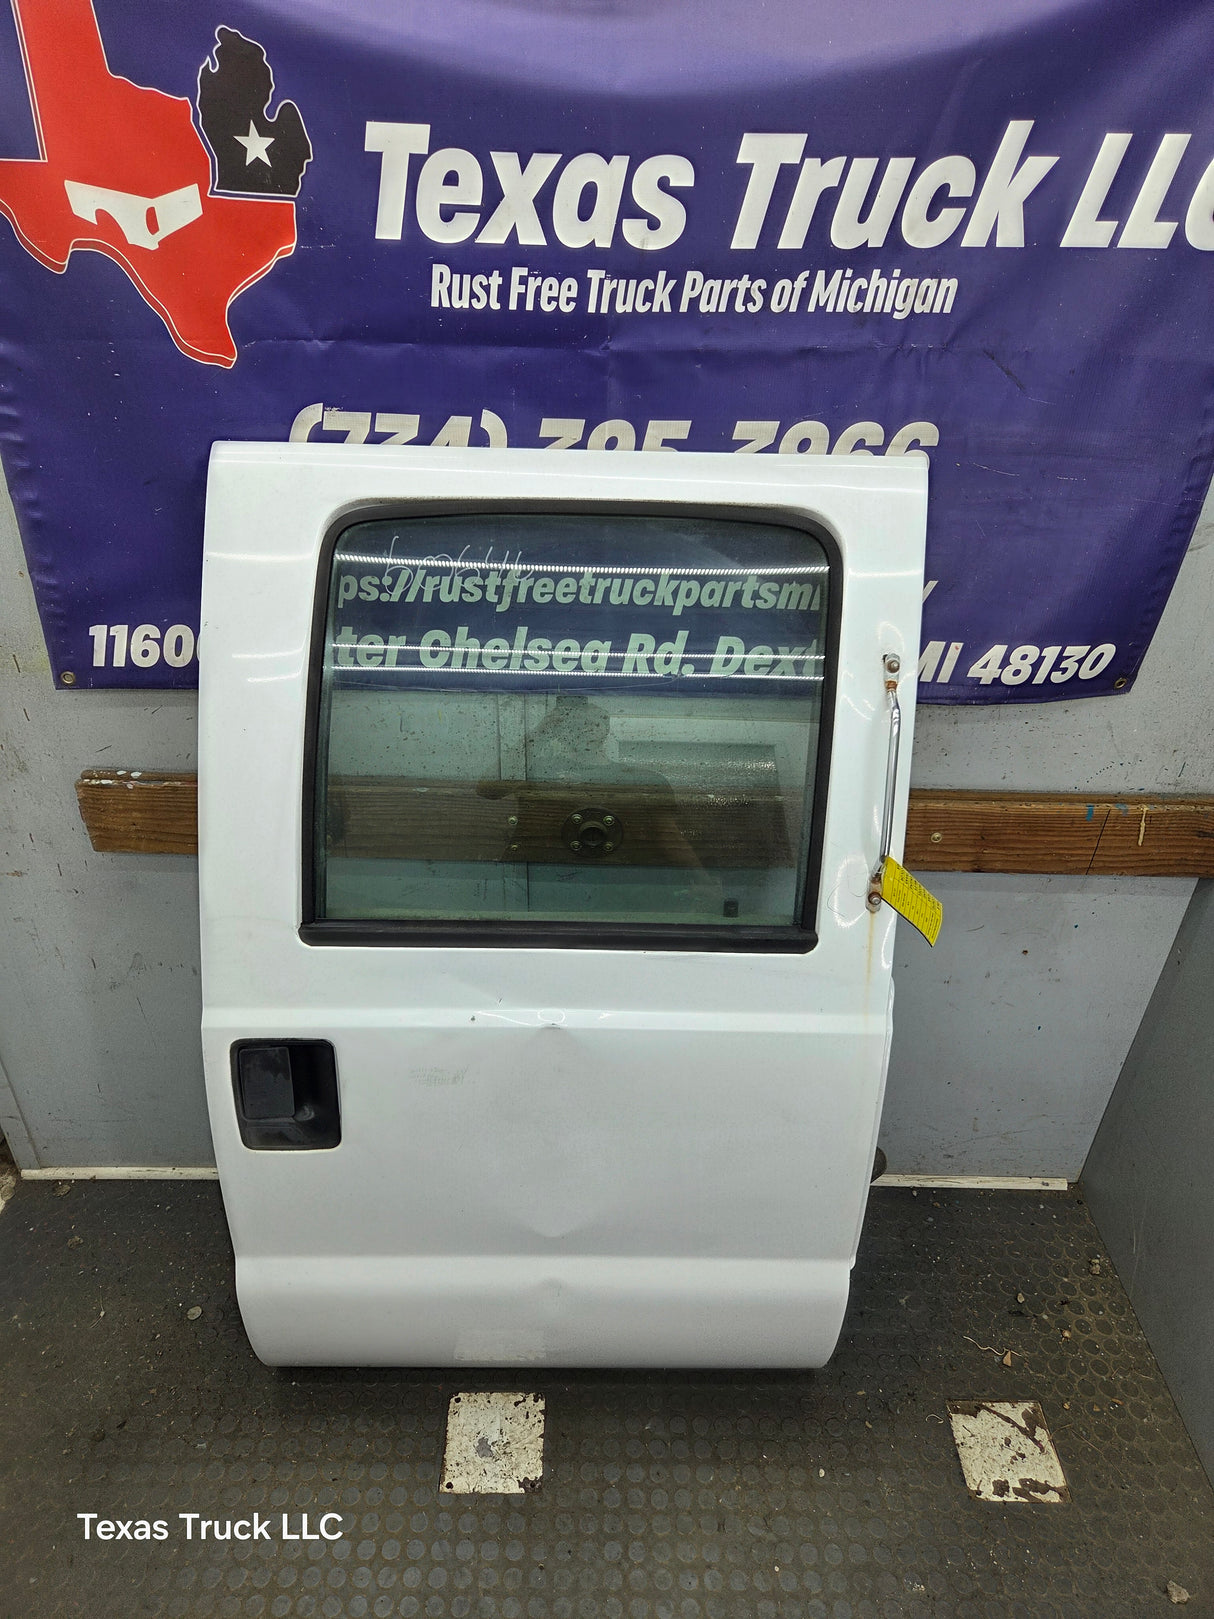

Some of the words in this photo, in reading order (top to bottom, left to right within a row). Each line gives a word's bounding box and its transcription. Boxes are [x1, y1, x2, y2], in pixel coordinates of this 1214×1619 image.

[365, 121, 695, 250] Texas
[730, 119, 1061, 250] Truck
[431, 264, 502, 311] Rust
[509, 267, 578, 313] Free
[587, 270, 677, 314] Truck
[679, 270, 767, 313] Parts
[770, 269, 810, 313] of
[808, 268, 959, 320] Michigan
[89, 623, 200, 668] 1160
[335, 626, 407, 668] ter
[420, 626, 612, 675] Chelsea
[621, 630, 695, 676] Rd.
[967, 643, 1117, 686] 48130
